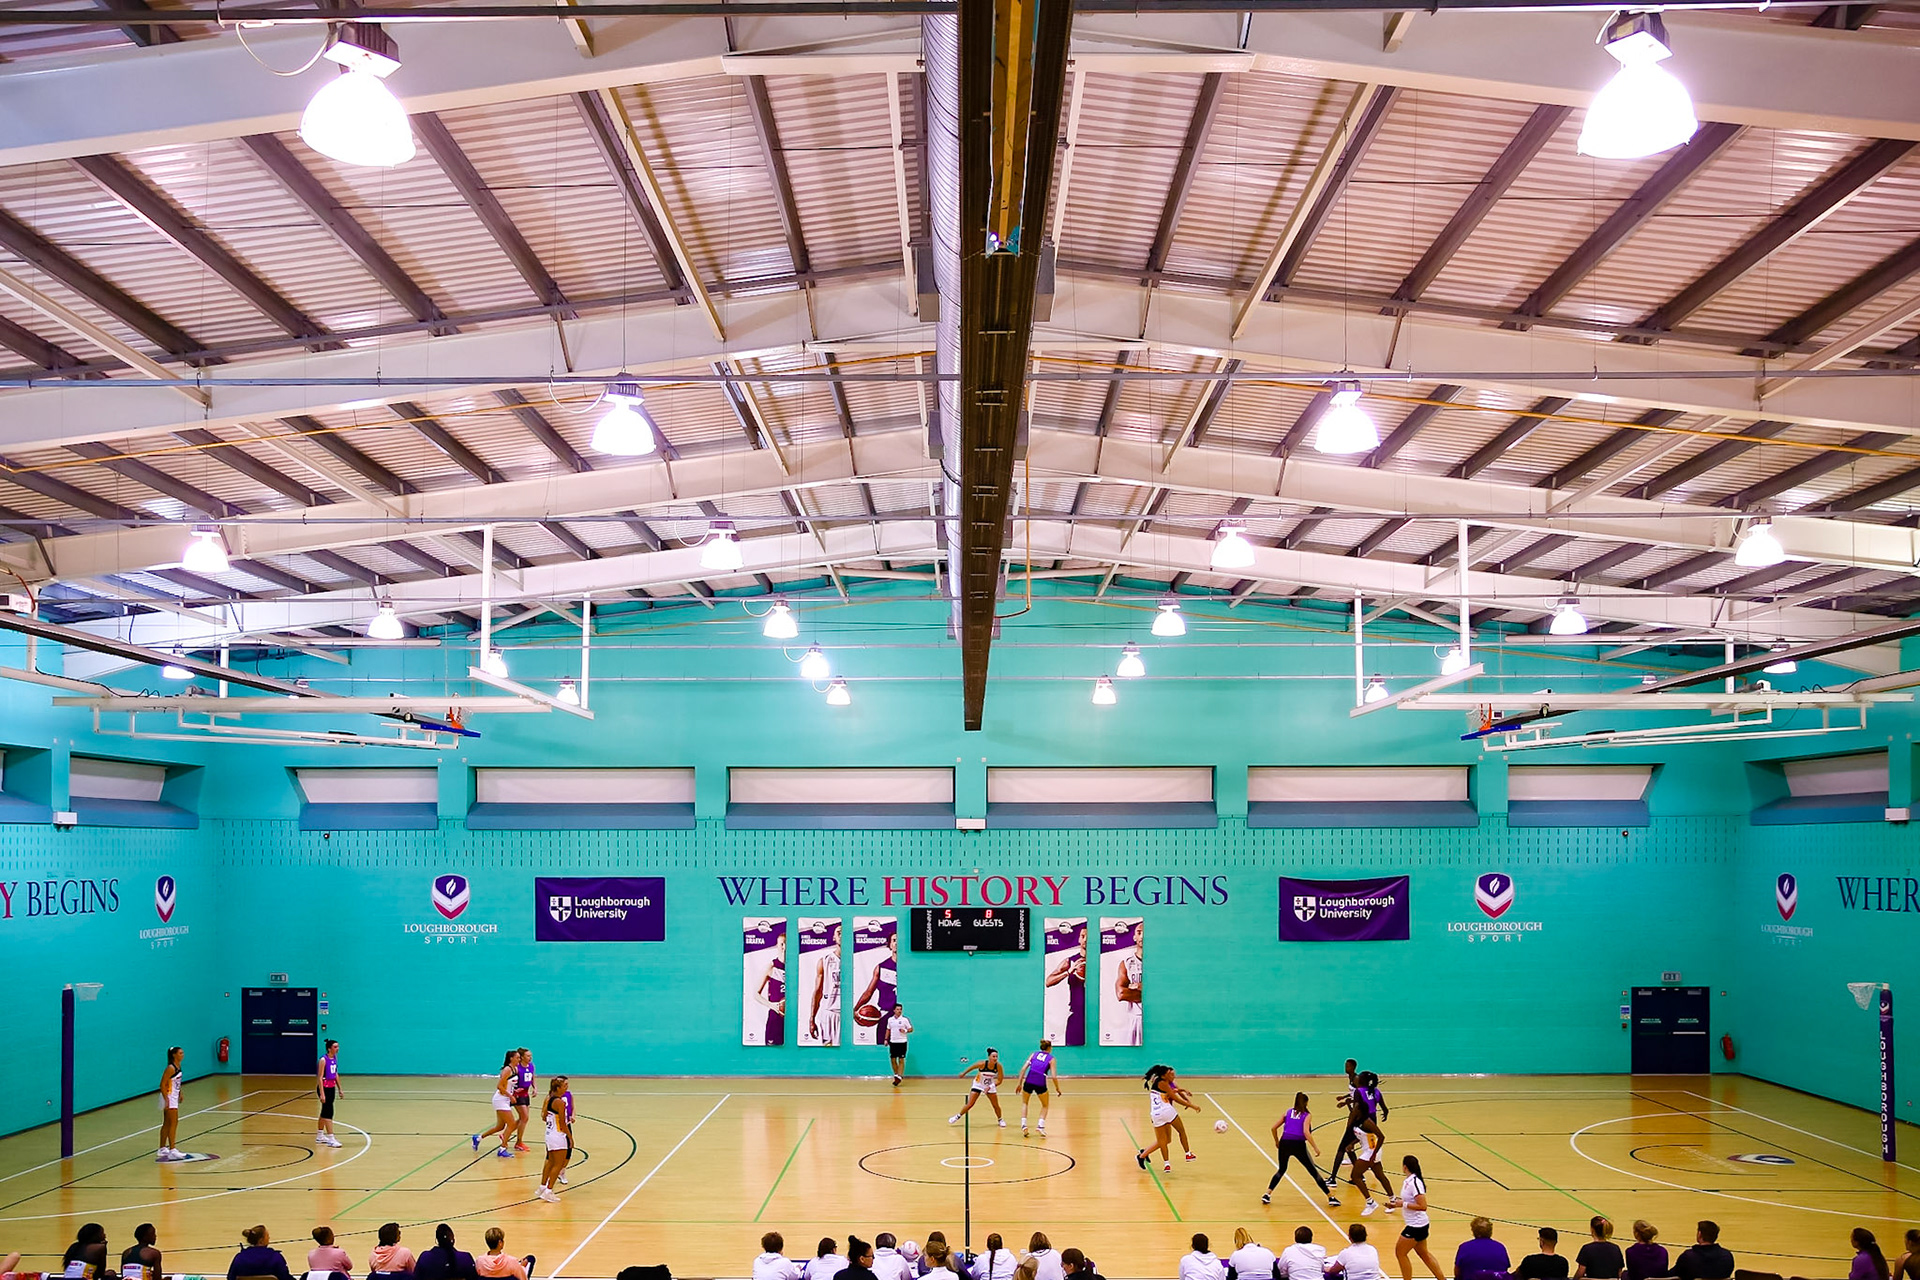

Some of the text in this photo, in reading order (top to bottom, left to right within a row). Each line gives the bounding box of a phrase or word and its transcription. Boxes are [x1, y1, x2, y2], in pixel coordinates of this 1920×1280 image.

[717, 876, 1228, 906] WHERE HISTORY BEGINS
[26, 878, 120, 917] BEGINS
[575, 896, 650, 908] Loughborough
[1319, 896, 1394, 908] Loughborough
[575, 908, 627, 920] University
[1319, 908, 1372, 920] University
[404, 924, 498, 933] LOUGHBOROUGH
[938, 919, 961, 927] HOME
[973, 919, 1003, 927] GUESTS
[1448, 922, 1542, 932] LOUGHBOROUGH
[139, 926, 189, 939] LOUGHBOROUGH
[1761, 924, 1813, 937] LOUGHBOROUGH
[424, 936, 478, 944] SPORT
[1468, 934, 1522, 942] SPORT
[1879, 1031, 1888, 1154] LOUGHBOROUGH
